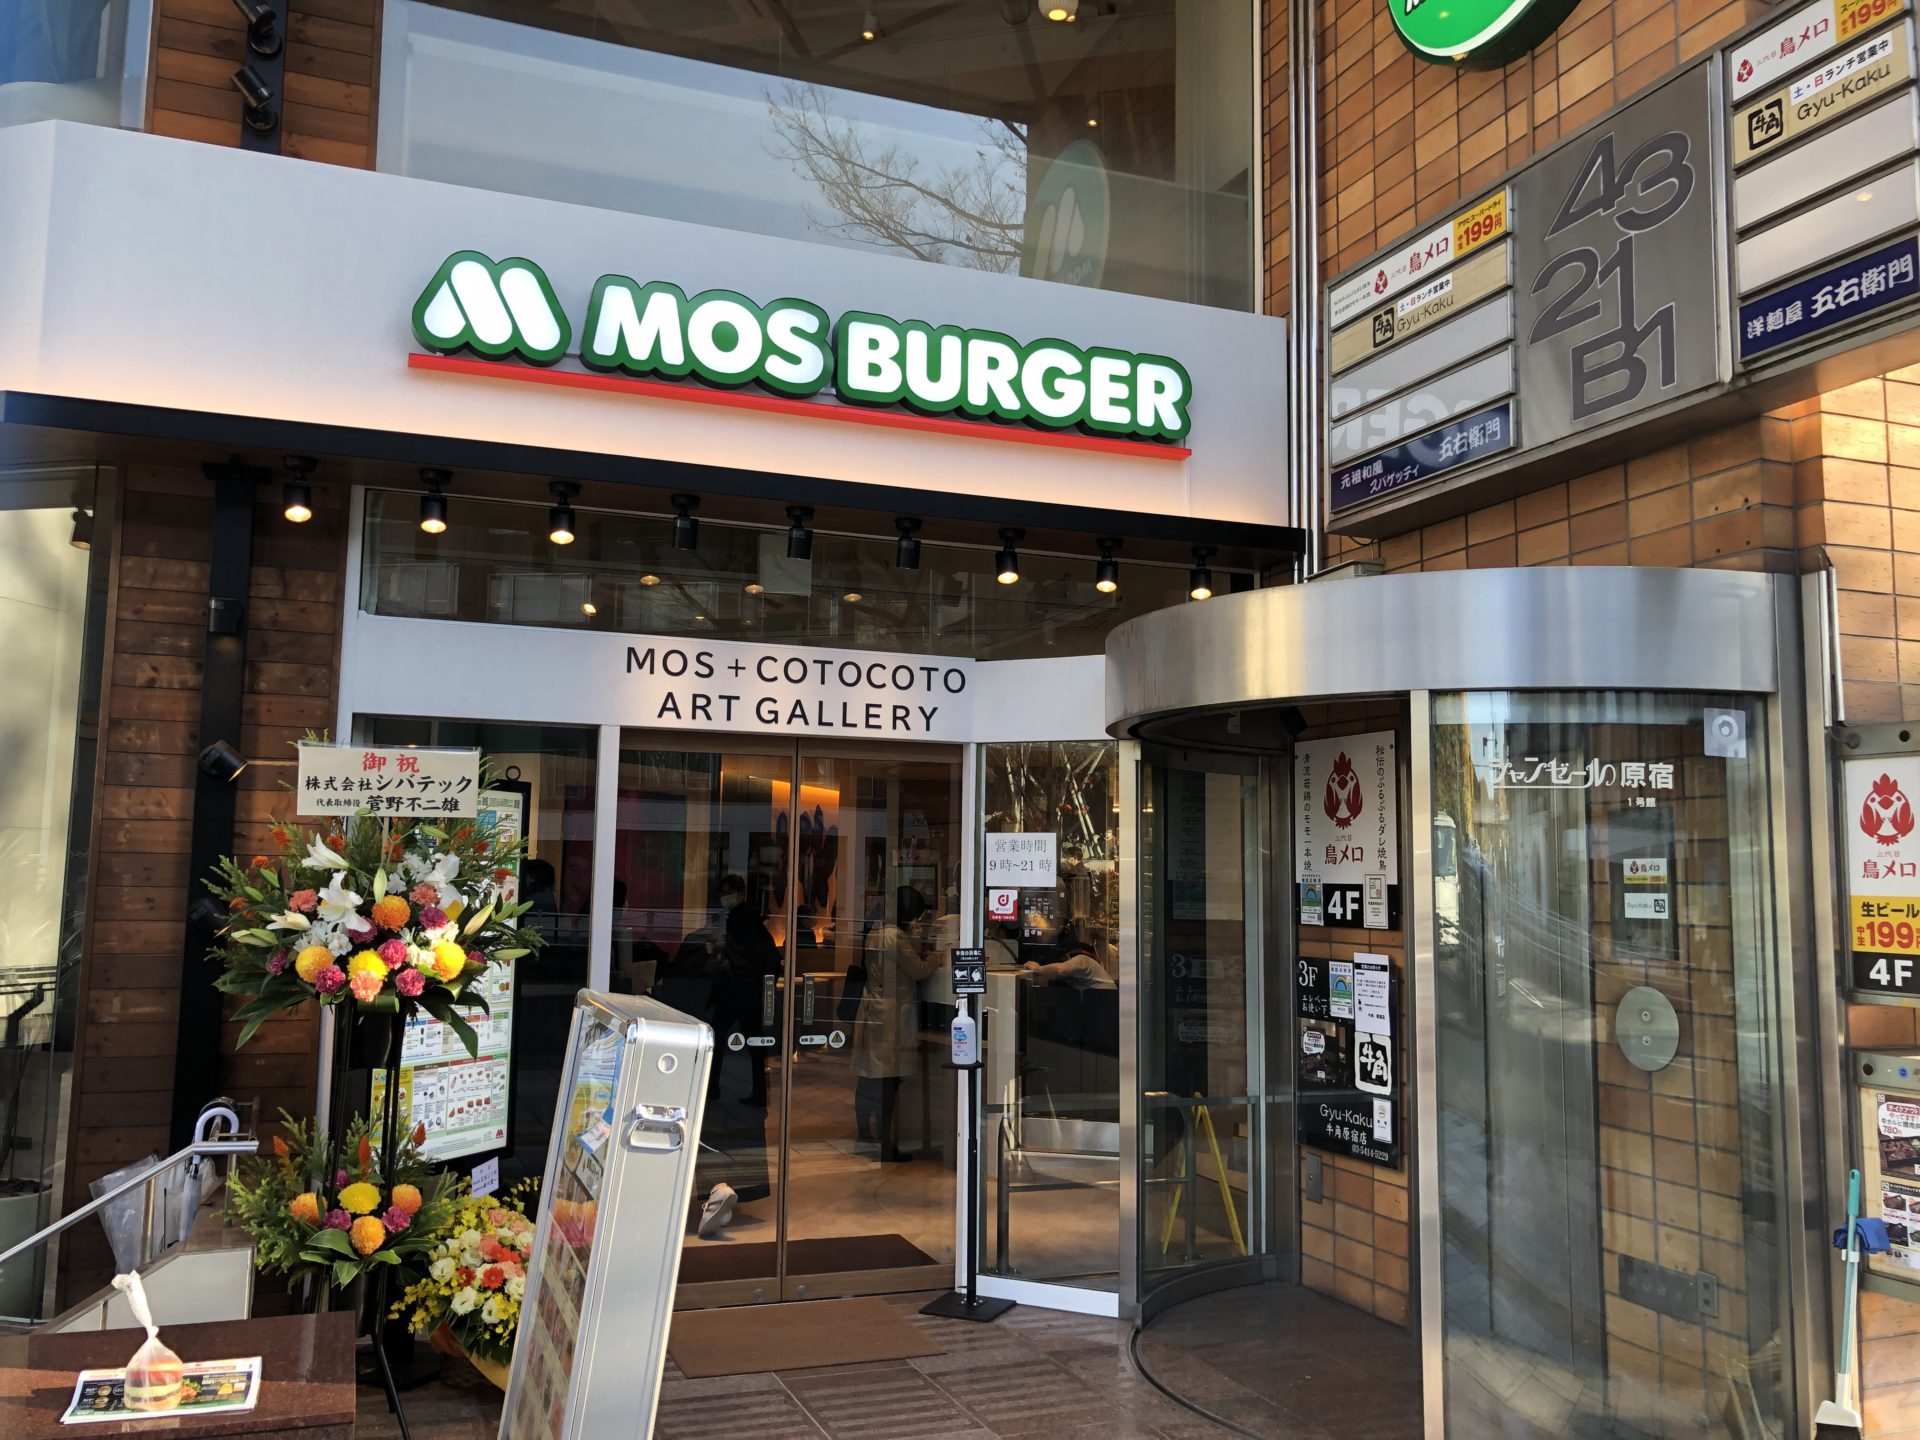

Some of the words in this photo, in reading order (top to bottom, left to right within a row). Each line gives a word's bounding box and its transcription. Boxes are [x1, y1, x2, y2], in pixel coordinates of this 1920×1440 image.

[1779, 18, 1829, 59] 鳥メロ
[1793, 39, 1889, 100] 土・日ランチ営業中
[1797, 64, 1891, 121] Gyu-Kaku
[1463, 214, 1494, 246] 199
[1408, 237, 1449, 275] 鳥メロ
[1810, 253, 1914, 319] 五右衛門
[1397, 295, 1454, 332] Gyu-Kaku
[593, 285, 824, 384] MOS
[847, 321, 1184, 431] BURGER
[1438, 416, 1501, 462] 五右衛門
[1340, 460, 1384, 490] 元祖和風
[626, 646, 715, 679] MOS
[756, 655, 966, 694] COTOCOTO
[657, 691, 741, 722] ART
[755, 697, 939, 732] GALLERY
[305, 773, 473, 792] 株式会社シバテック
[316, 798, 361, 808] 代表取締役
[366, 795, 461, 813] 菅野不二雄
[995, 839, 1047, 852] 営業時間
[1324, 844, 1364, 865] 鳥メロ
[1862, 859, 1917, 880] 鳥メロ
[1328, 890, 1360, 920] 4F
[1861, 901, 1920, 919] 生ビール
[1866, 921, 1913, 949] 199
[1299, 960, 1319, 987] 3F
[1869, 958, 1913, 987] 4F
[1320, 1104, 1373, 1129] Gyu-Kaku
[1326, 1122, 1367, 1145] 牛角原宿店
